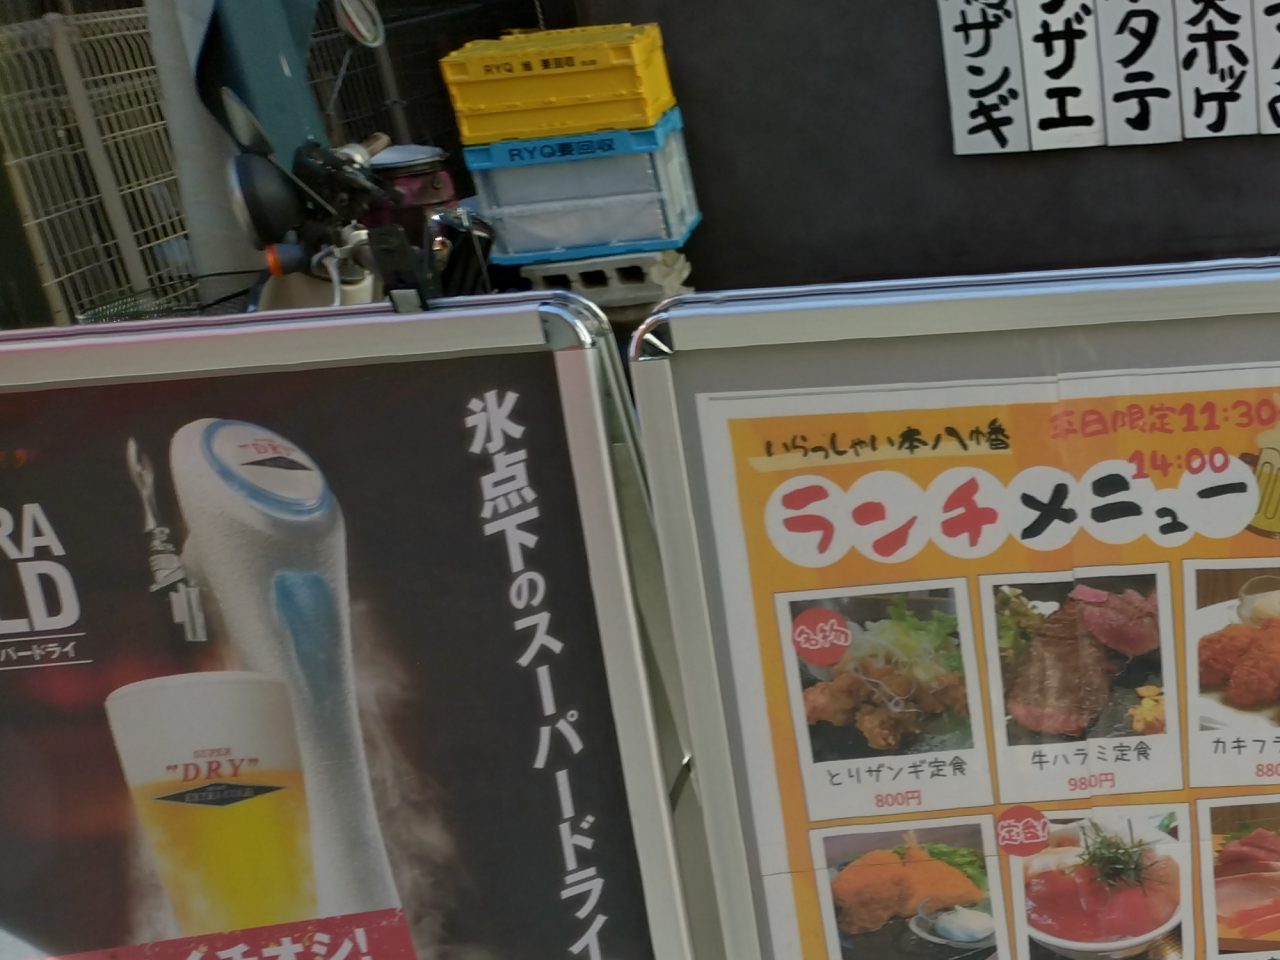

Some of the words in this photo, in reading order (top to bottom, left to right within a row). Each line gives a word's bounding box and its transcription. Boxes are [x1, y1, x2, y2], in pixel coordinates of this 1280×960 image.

[954, 0, 1019, 148] ザンギ
[1032, 0, 1094, 131] ザエ
[1110, 0, 1171, 131] タテ
[1127, 446, 1231, 480] 14:00
[781, 476, 1248, 558] ランチメニュー
[826, 755, 969, 787] とりザンギ定食
[1031, 740, 1152, 771] 牛ハラミ定食
[874, 789, 923, 808] 800円
[1068, 772, 1116, 792] 980円
